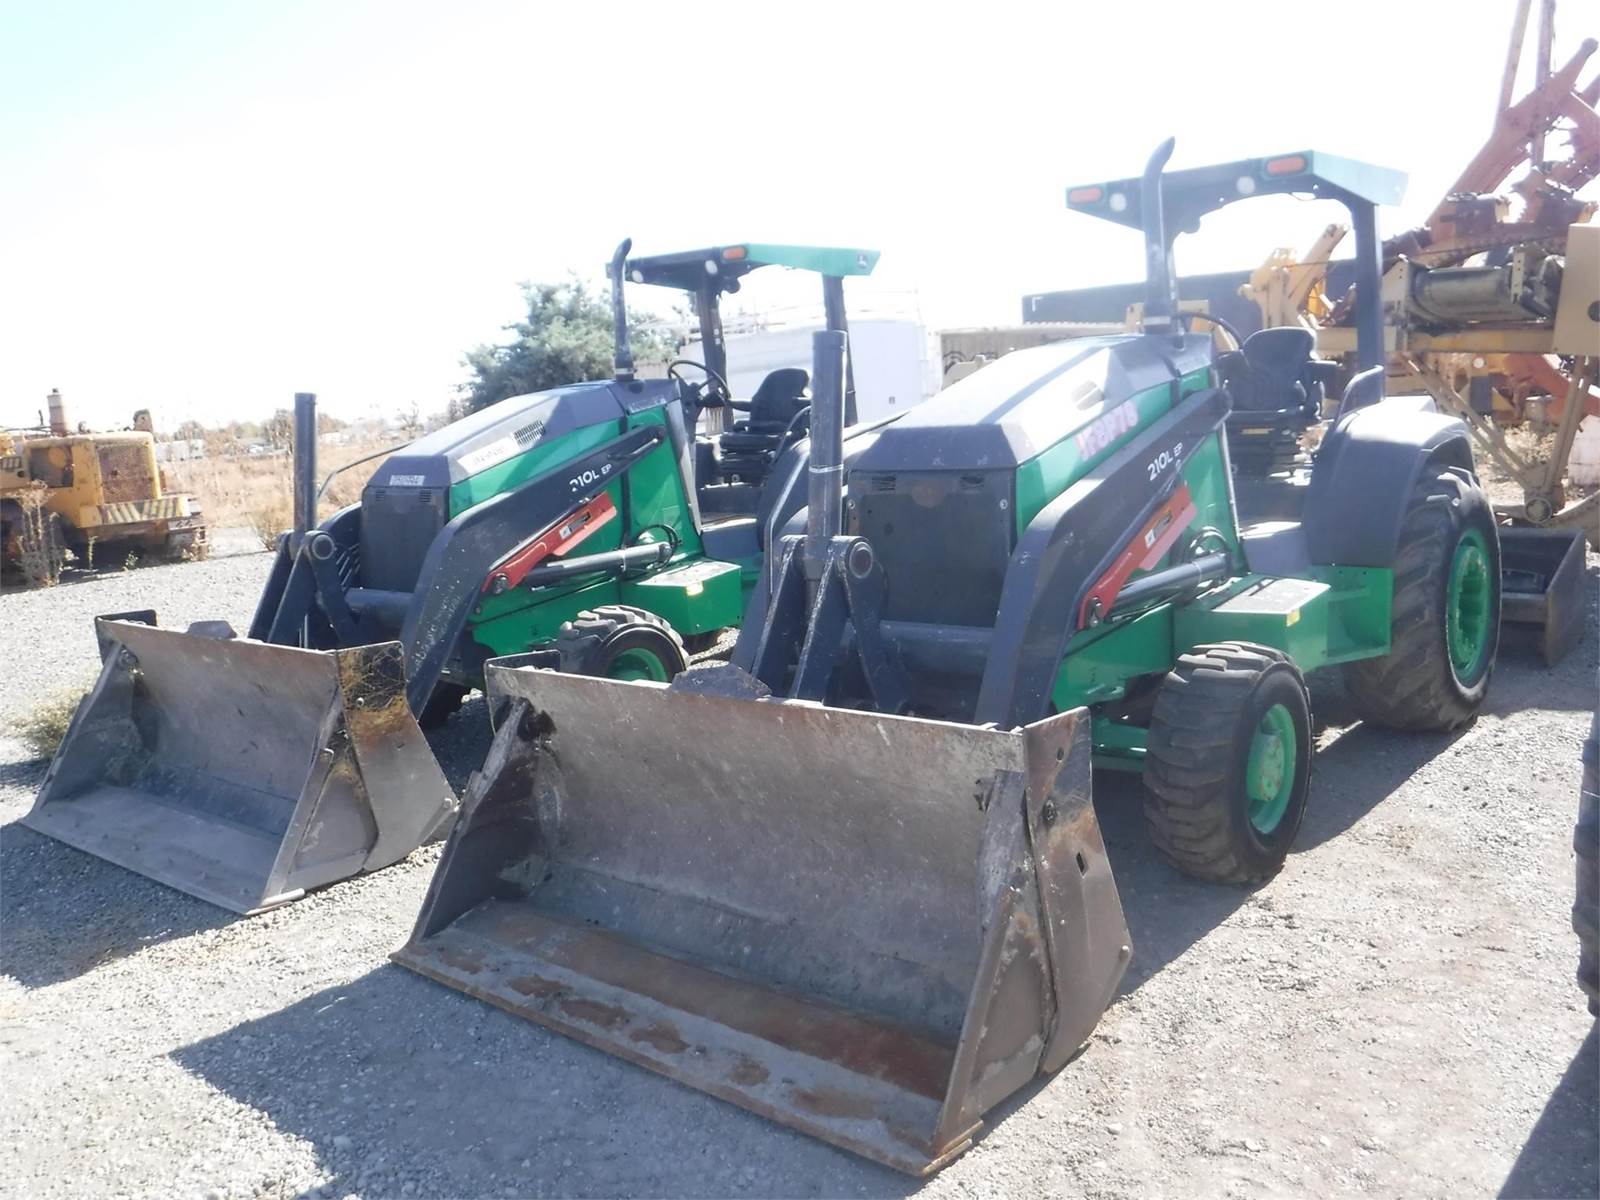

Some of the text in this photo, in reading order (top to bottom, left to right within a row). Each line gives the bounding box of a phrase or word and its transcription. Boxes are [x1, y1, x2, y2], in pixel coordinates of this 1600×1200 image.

[569, 463, 612, 492] 210L EP
[1147, 442, 1183, 481] 210L EP
